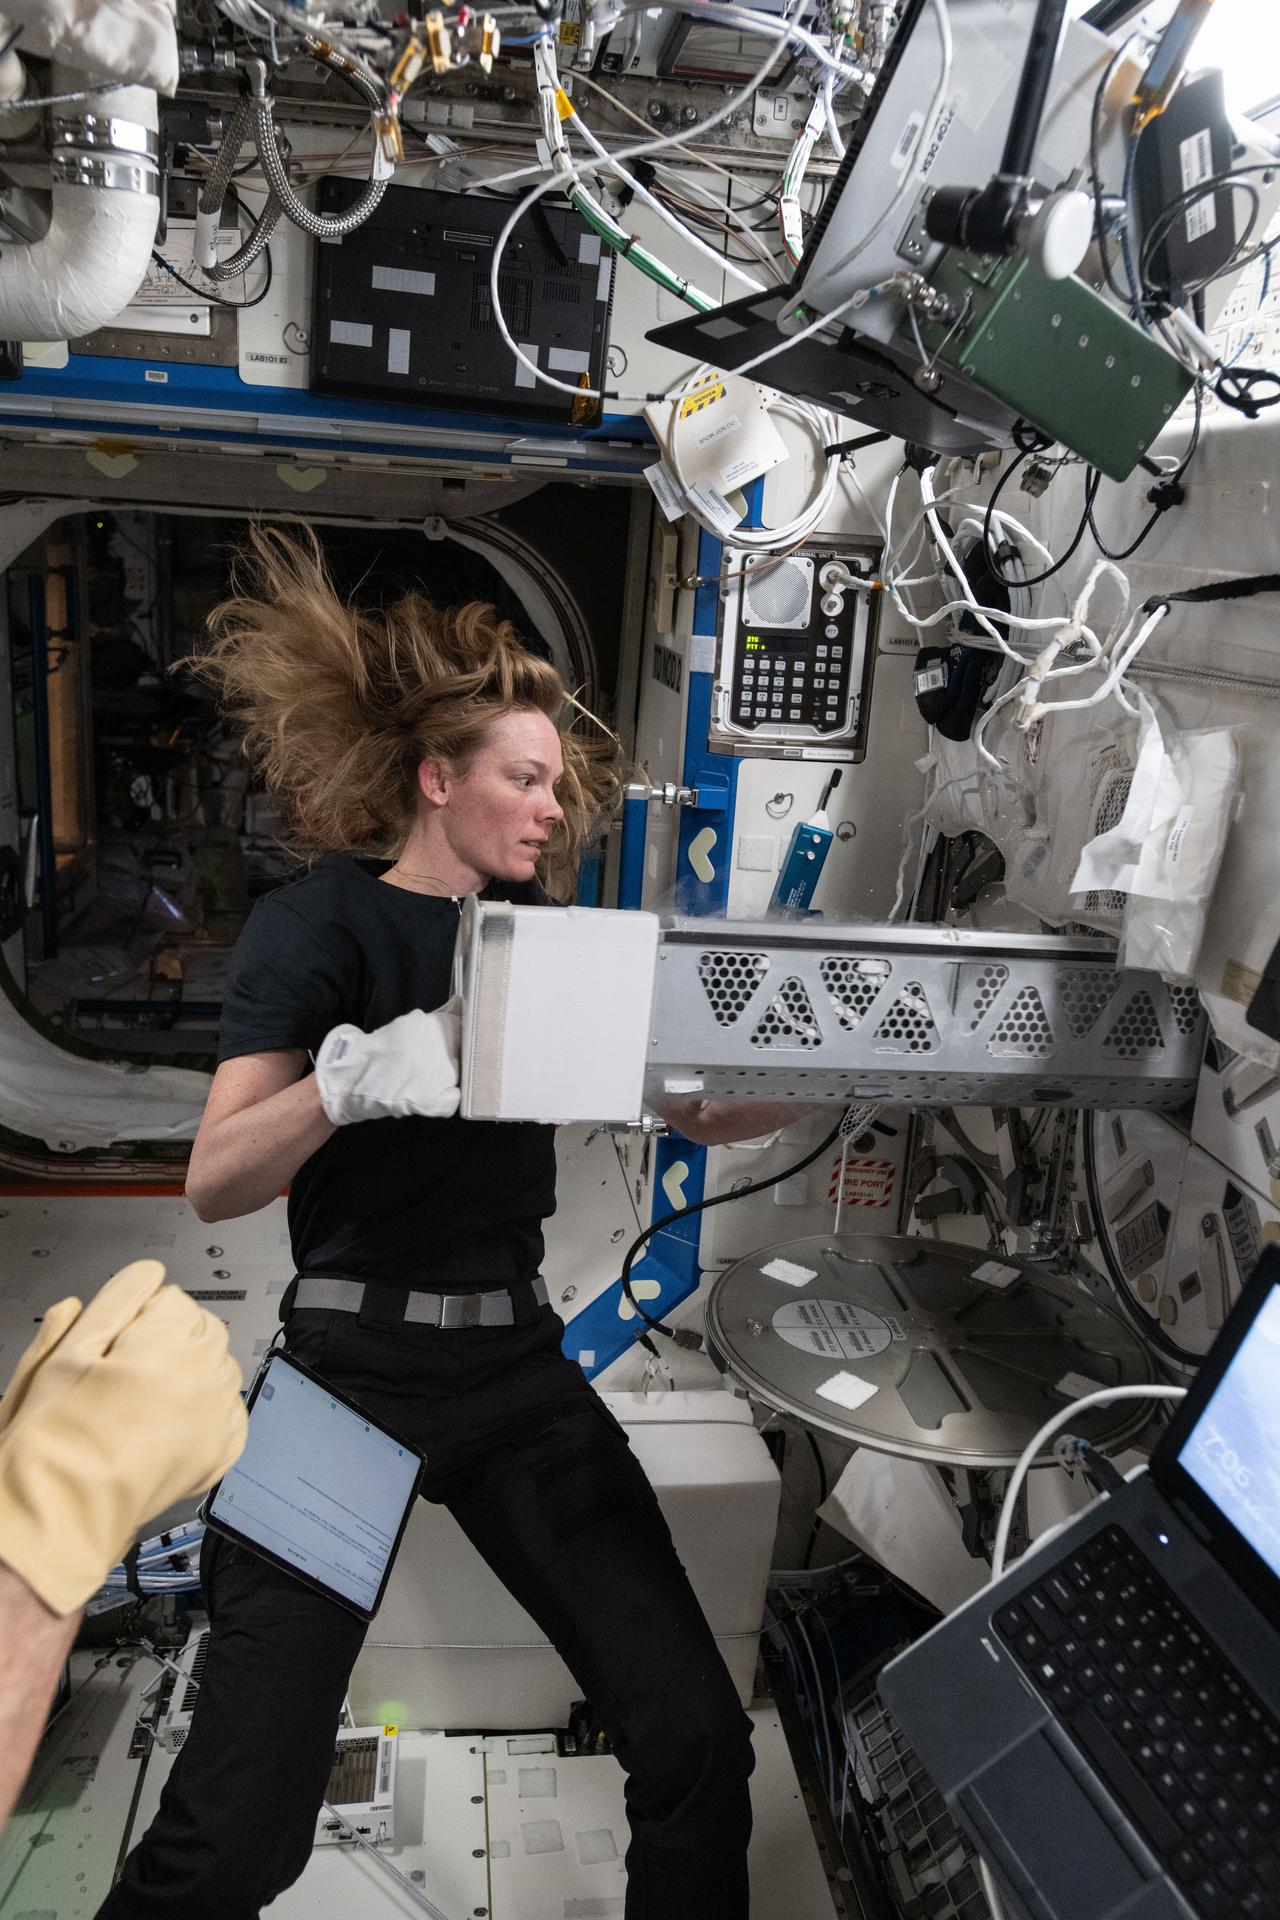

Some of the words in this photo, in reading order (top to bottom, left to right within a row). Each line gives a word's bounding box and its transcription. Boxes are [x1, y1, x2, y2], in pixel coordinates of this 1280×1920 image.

[920, 142, 940, 175] DESK
[694, 390, 717, 405] WARNING
[715, 425, 727, 435] NOT
[698, 431, 717, 444] MOVE
[846, 1167, 876, 1176] MERGENCY
[844, 1179, 859, 1187] IRE
[860, 1180, 885, 1189] PORT
[1203, 1424, 1253, 1489] 7:06
